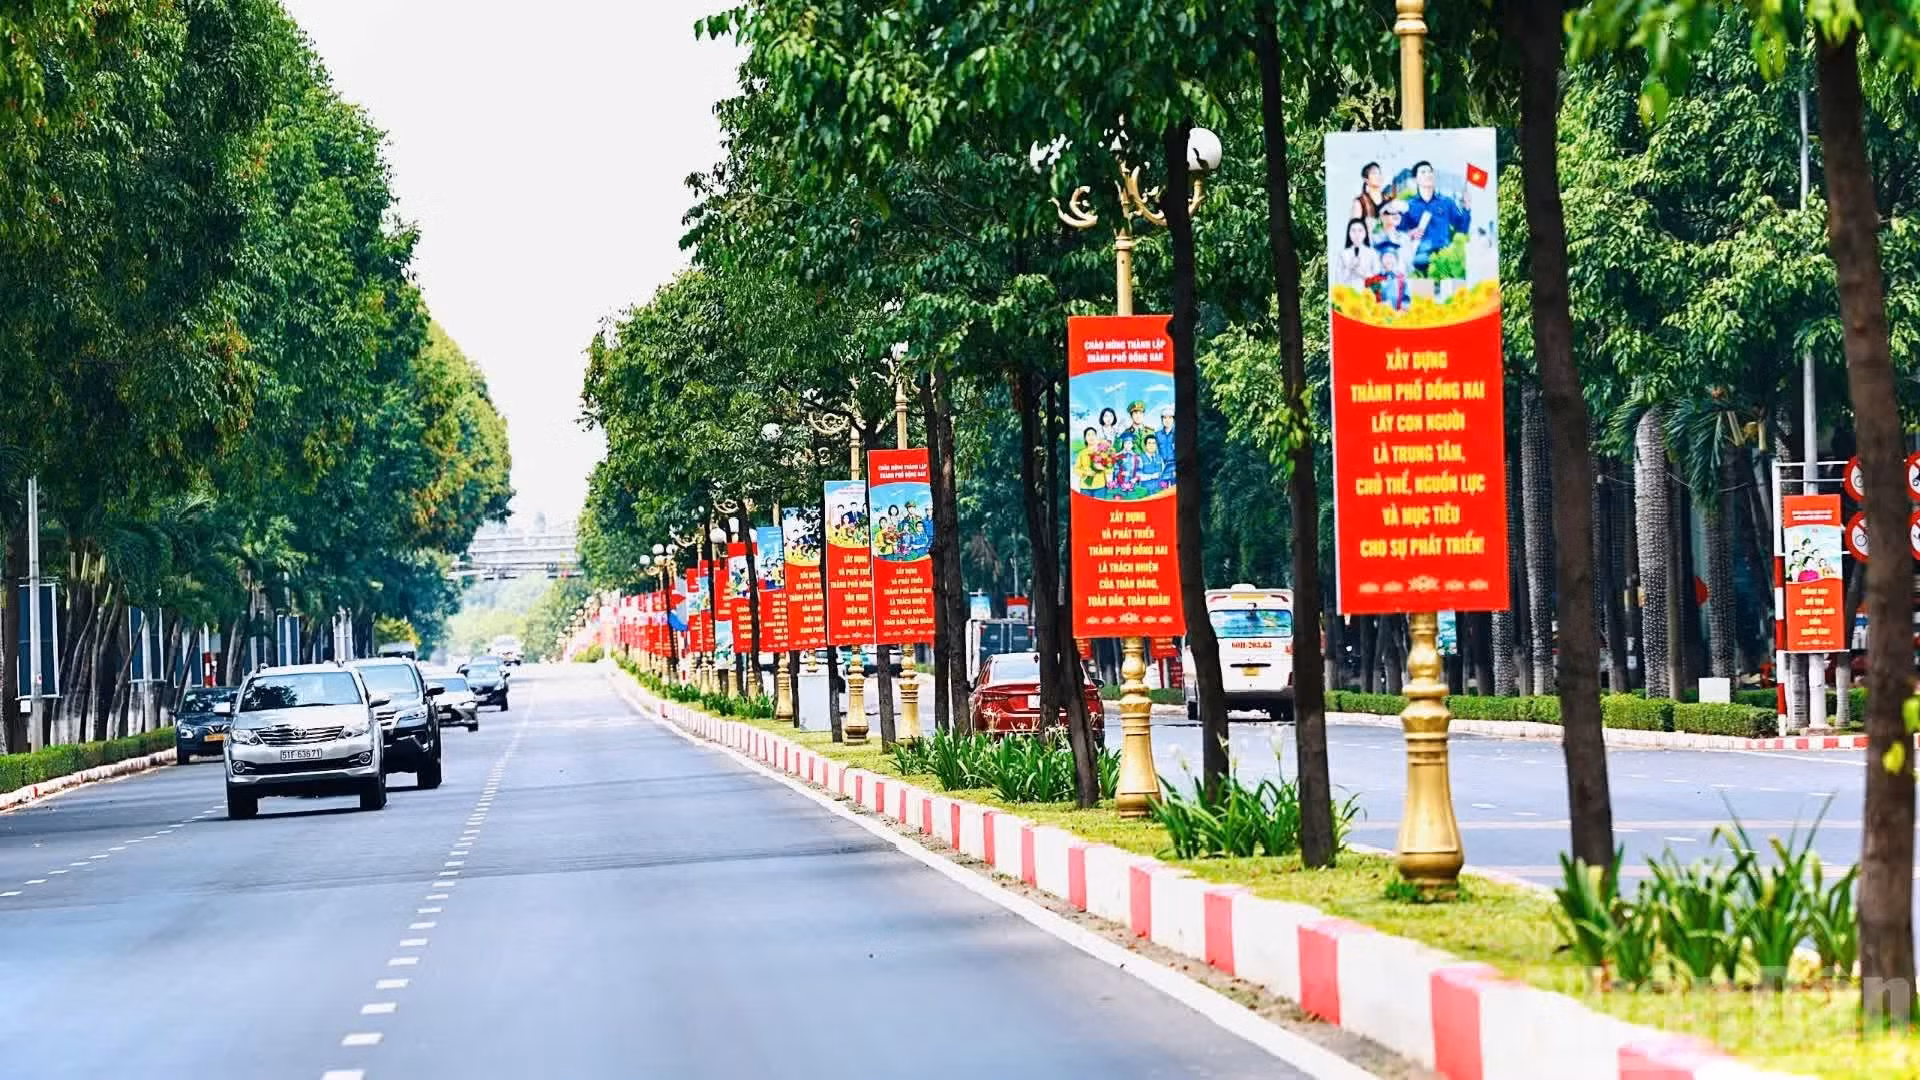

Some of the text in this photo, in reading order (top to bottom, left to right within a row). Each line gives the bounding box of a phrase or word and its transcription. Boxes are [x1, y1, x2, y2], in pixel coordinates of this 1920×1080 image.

[1386, 348, 1448, 373] XÂY DỰNG
[1351, 378, 1485, 403] THÀNH PHỐ ĐỒNG NAI
[1371, 408, 1465, 432] LẤY CON NGƯỜI
[1373, 440, 1466, 464] LÀ TRUNG TÂM,
[1356, 472, 1382, 495] CHỦ
[1414, 469, 1458, 493] NGUỒN
[1461, 474, 1485, 496] LỰC
[1382, 502, 1460, 528] VÀ MỤC TIÊU
[1360, 539, 1387, 557] CHO
[1390, 539, 1408, 560] SỰ
[1410, 533, 1443, 556] PHÁT
